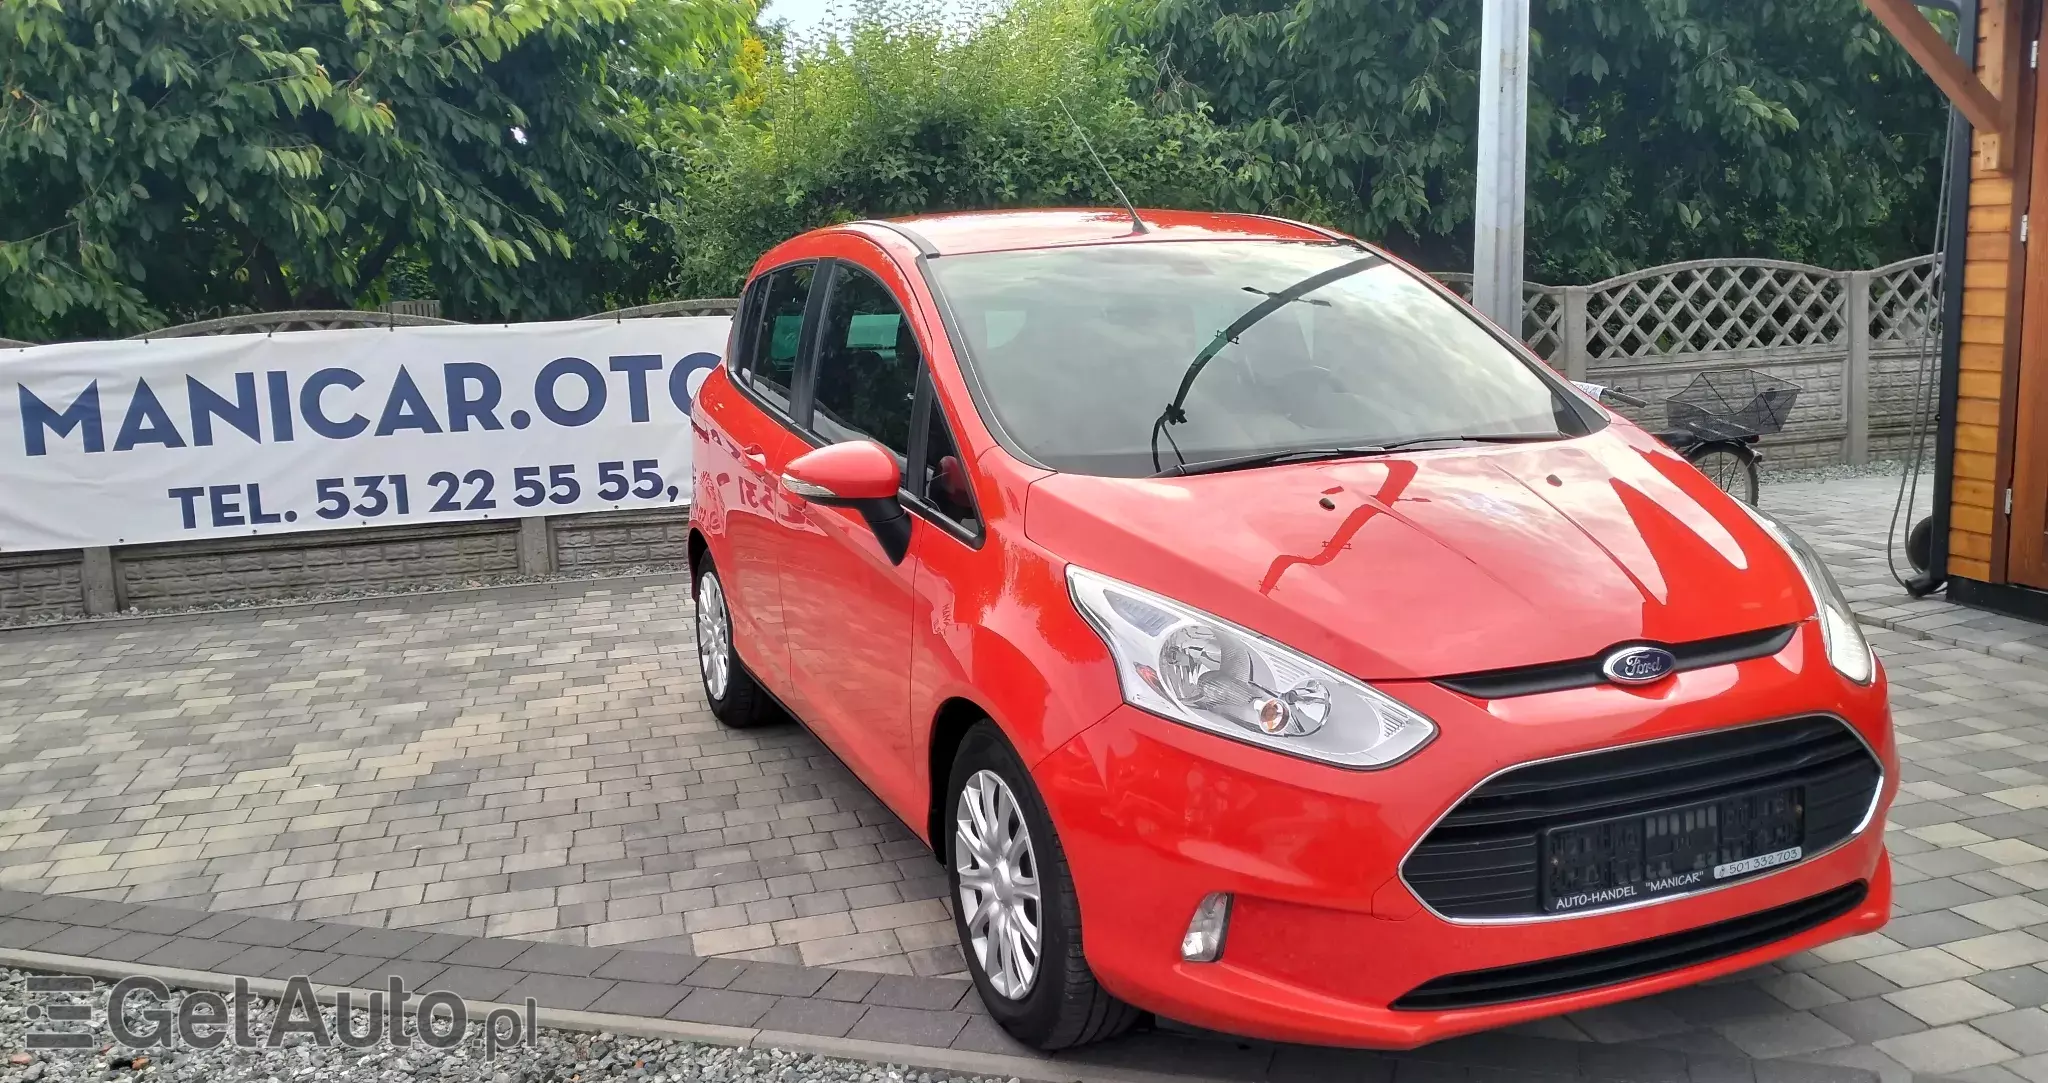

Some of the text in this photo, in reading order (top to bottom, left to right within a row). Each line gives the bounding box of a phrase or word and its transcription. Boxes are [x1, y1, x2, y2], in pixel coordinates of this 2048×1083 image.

[168, 459, 680, 529] TEL. 531 22 55 55,
[1625, 654, 1662, 676] Ford
[1729, 849, 1799, 875] 501 332 703
[1556, 871, 1704, 910] AUTO-HANDEL "MANICAR"
